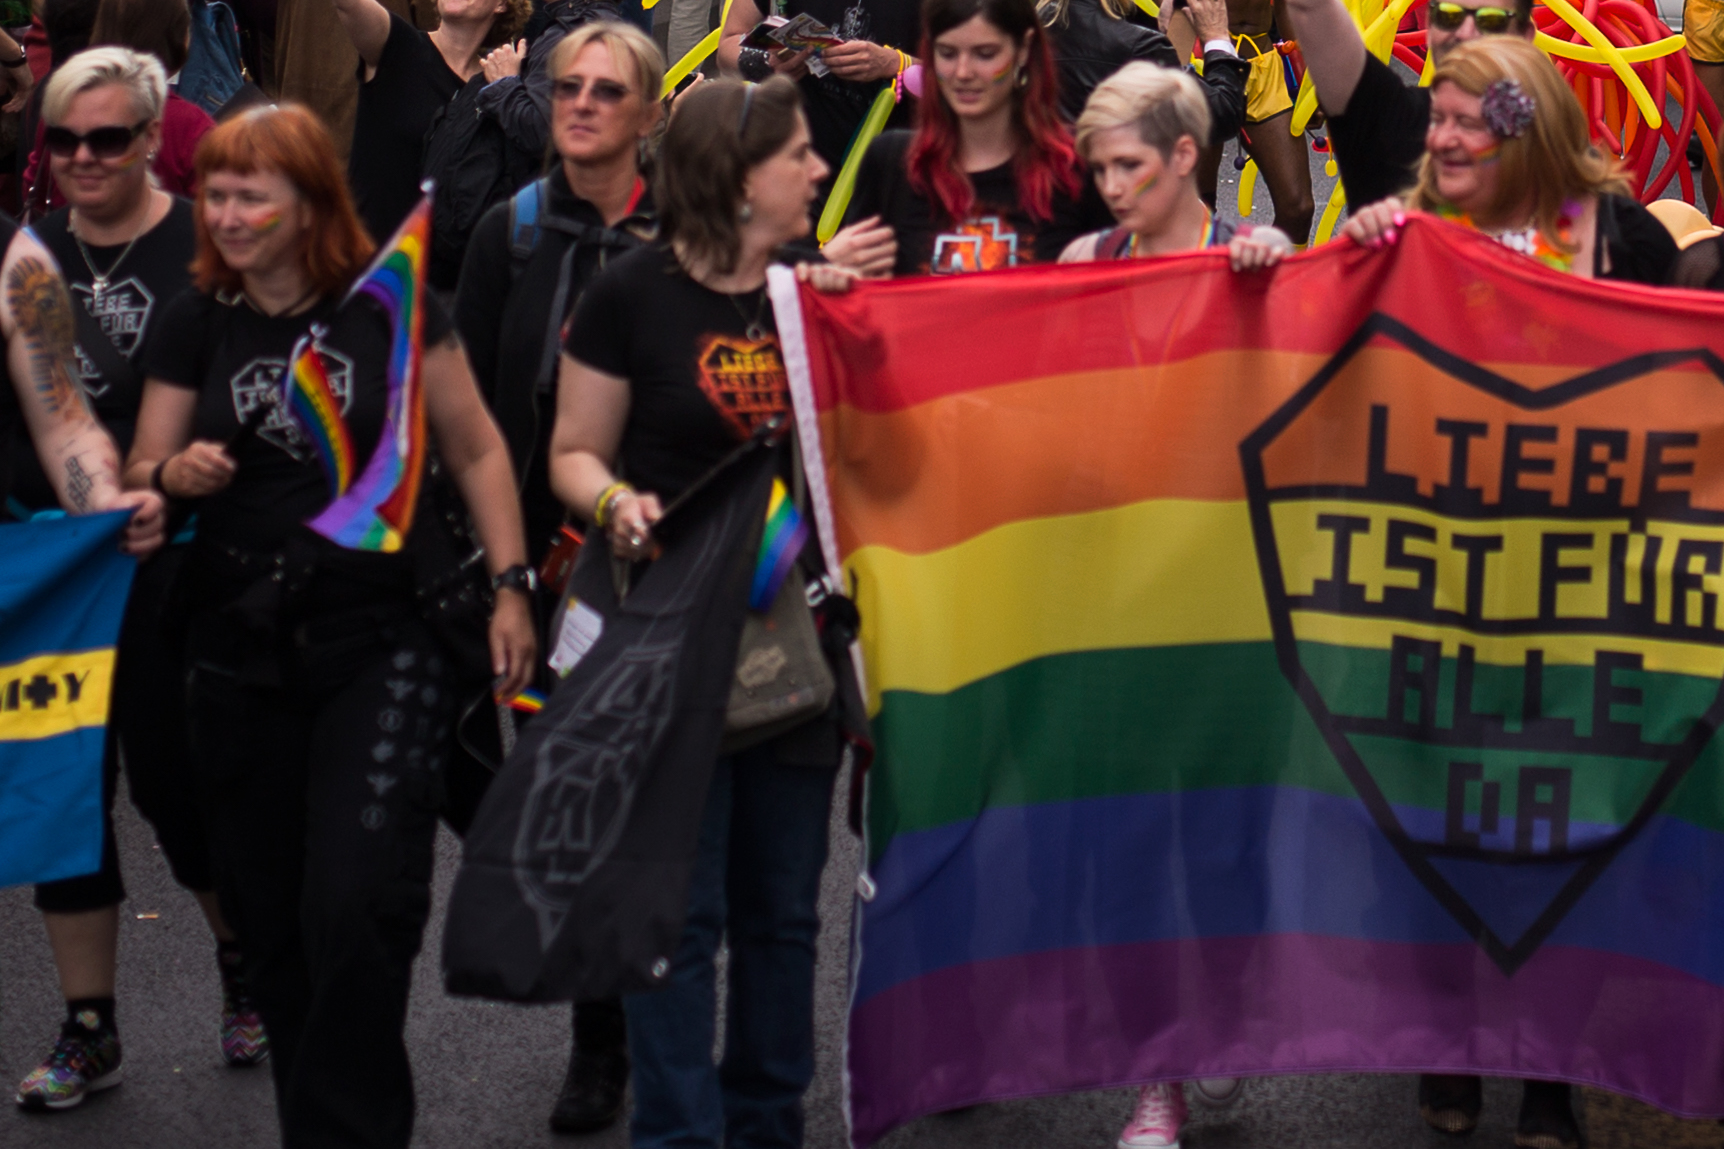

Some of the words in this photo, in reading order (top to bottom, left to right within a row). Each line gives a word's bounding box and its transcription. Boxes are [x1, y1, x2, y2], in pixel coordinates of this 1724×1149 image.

[1366, 404, 1699, 509] LIEBE
[1312, 513, 1505, 619] IST
[1386, 634, 1645, 746] ALLE
[1446, 761, 1573, 852] DA
